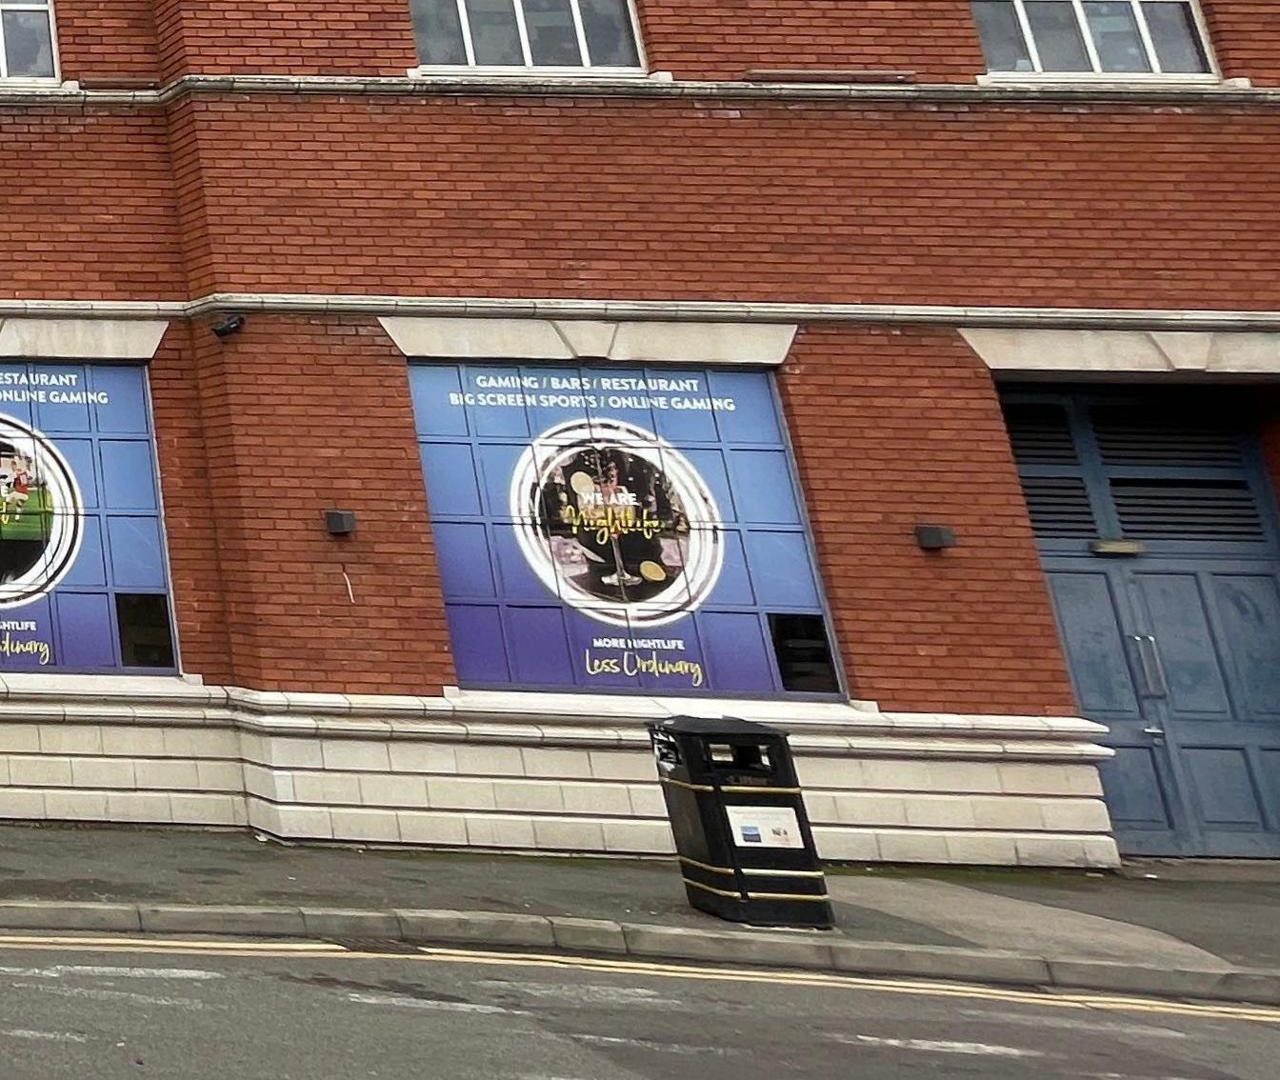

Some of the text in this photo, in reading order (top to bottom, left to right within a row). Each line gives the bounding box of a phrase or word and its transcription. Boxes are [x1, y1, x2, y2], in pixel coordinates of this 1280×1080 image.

[476, 375, 538, 389] GAMING
[550, 377, 590, 390] BARS
[601, 378, 700, 392] RESTAURANT
[49, 391, 108, 404] GAMING
[449, 392, 474, 405] BIG
[477, 393, 537, 406] SCREEN
[540, 394, 597, 408] SPORTS
[609, 396, 668, 410] ONLINE
[671, 397, 736, 411] GAMING
[581, 493, 638, 506] WE ARE
[561, 505, 662, 545] Nightlife
[593, 638, 626, 648] MORE
[584, 649, 621, 675] Less
